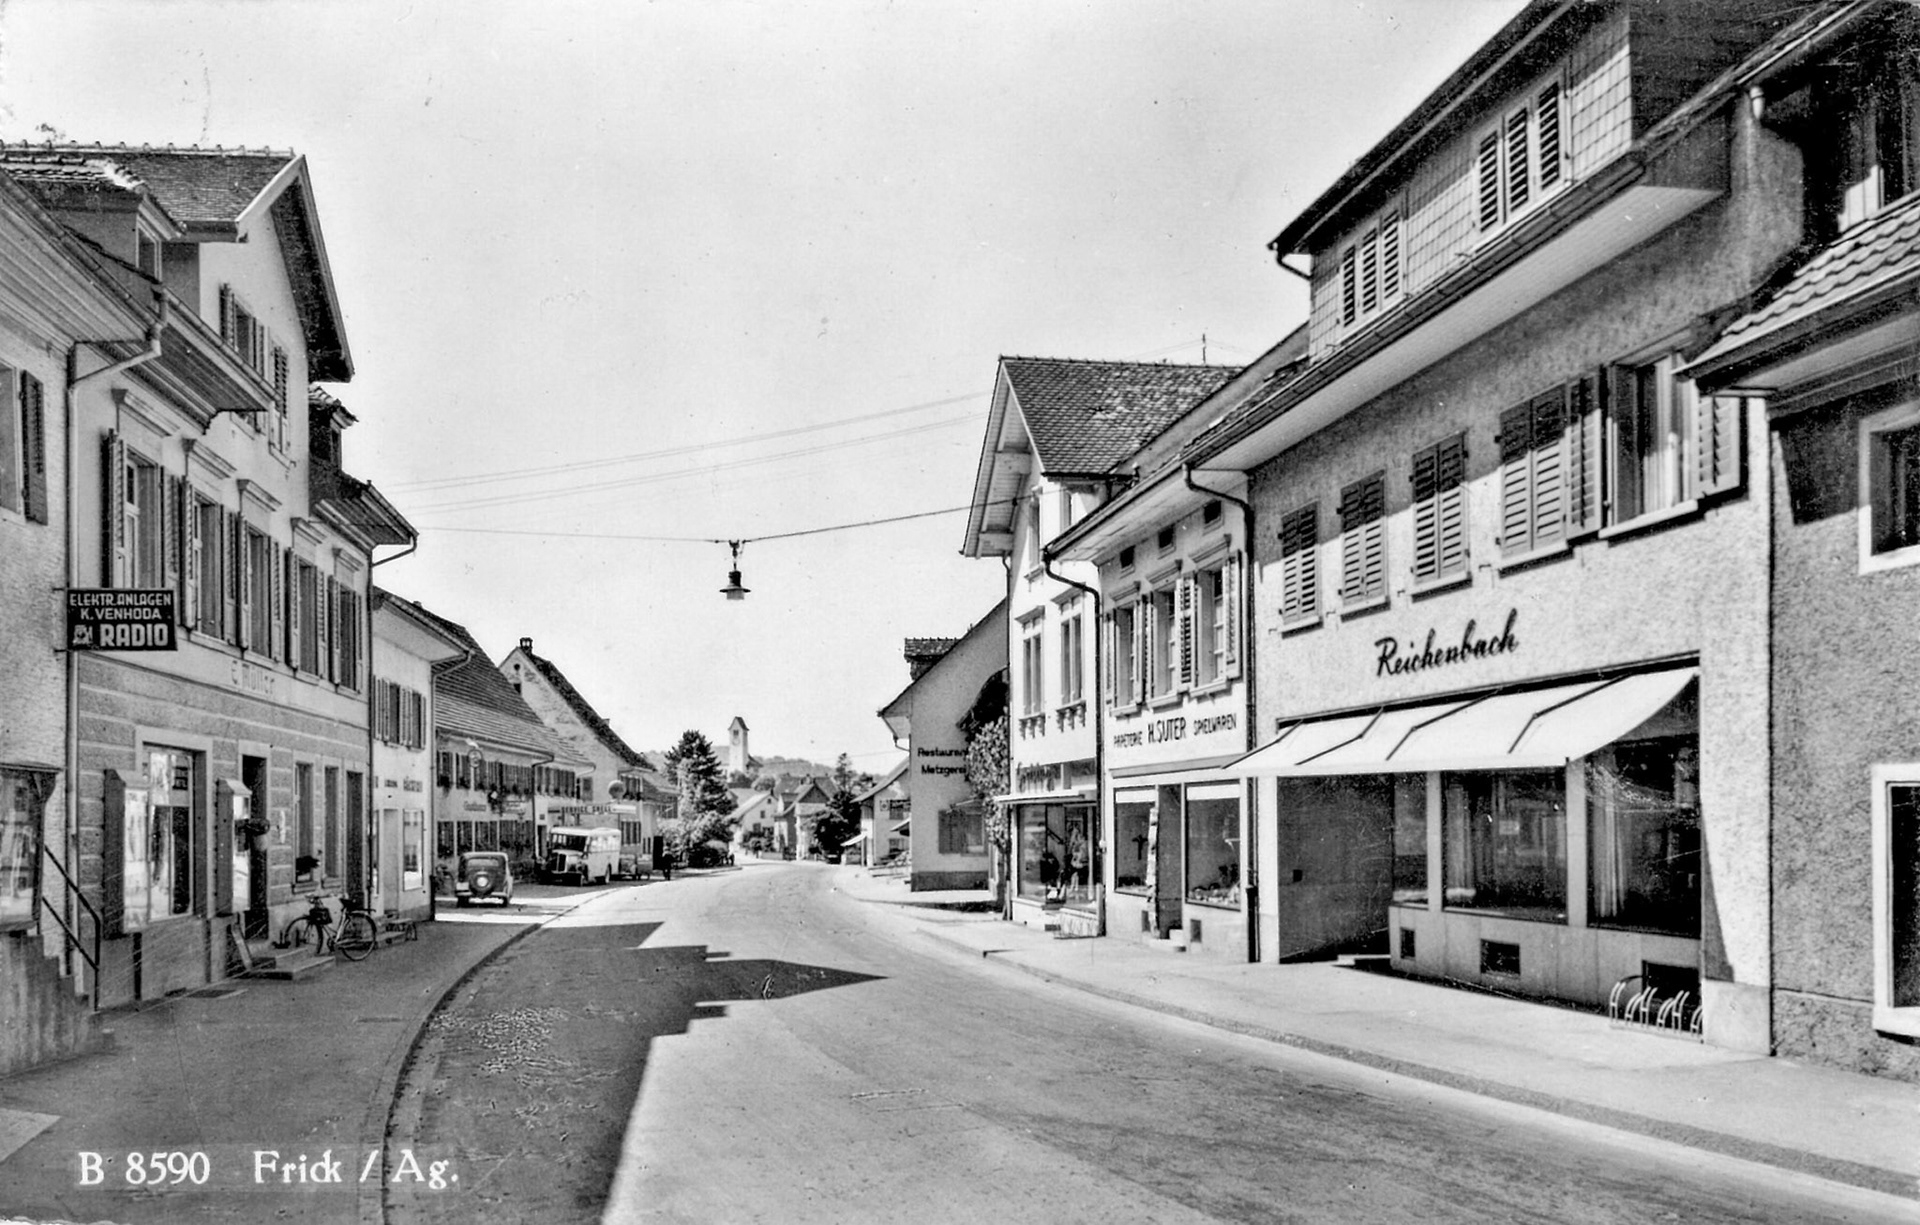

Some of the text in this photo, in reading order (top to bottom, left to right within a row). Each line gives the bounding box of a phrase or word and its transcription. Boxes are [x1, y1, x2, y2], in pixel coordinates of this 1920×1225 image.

[99, 623, 169, 647] RADIO
[1374, 607, 1519, 677] Reichenbach
[1193, 713, 1237, 736] SPIELWAREN
[921, 764, 967, 777] Metzgerei
